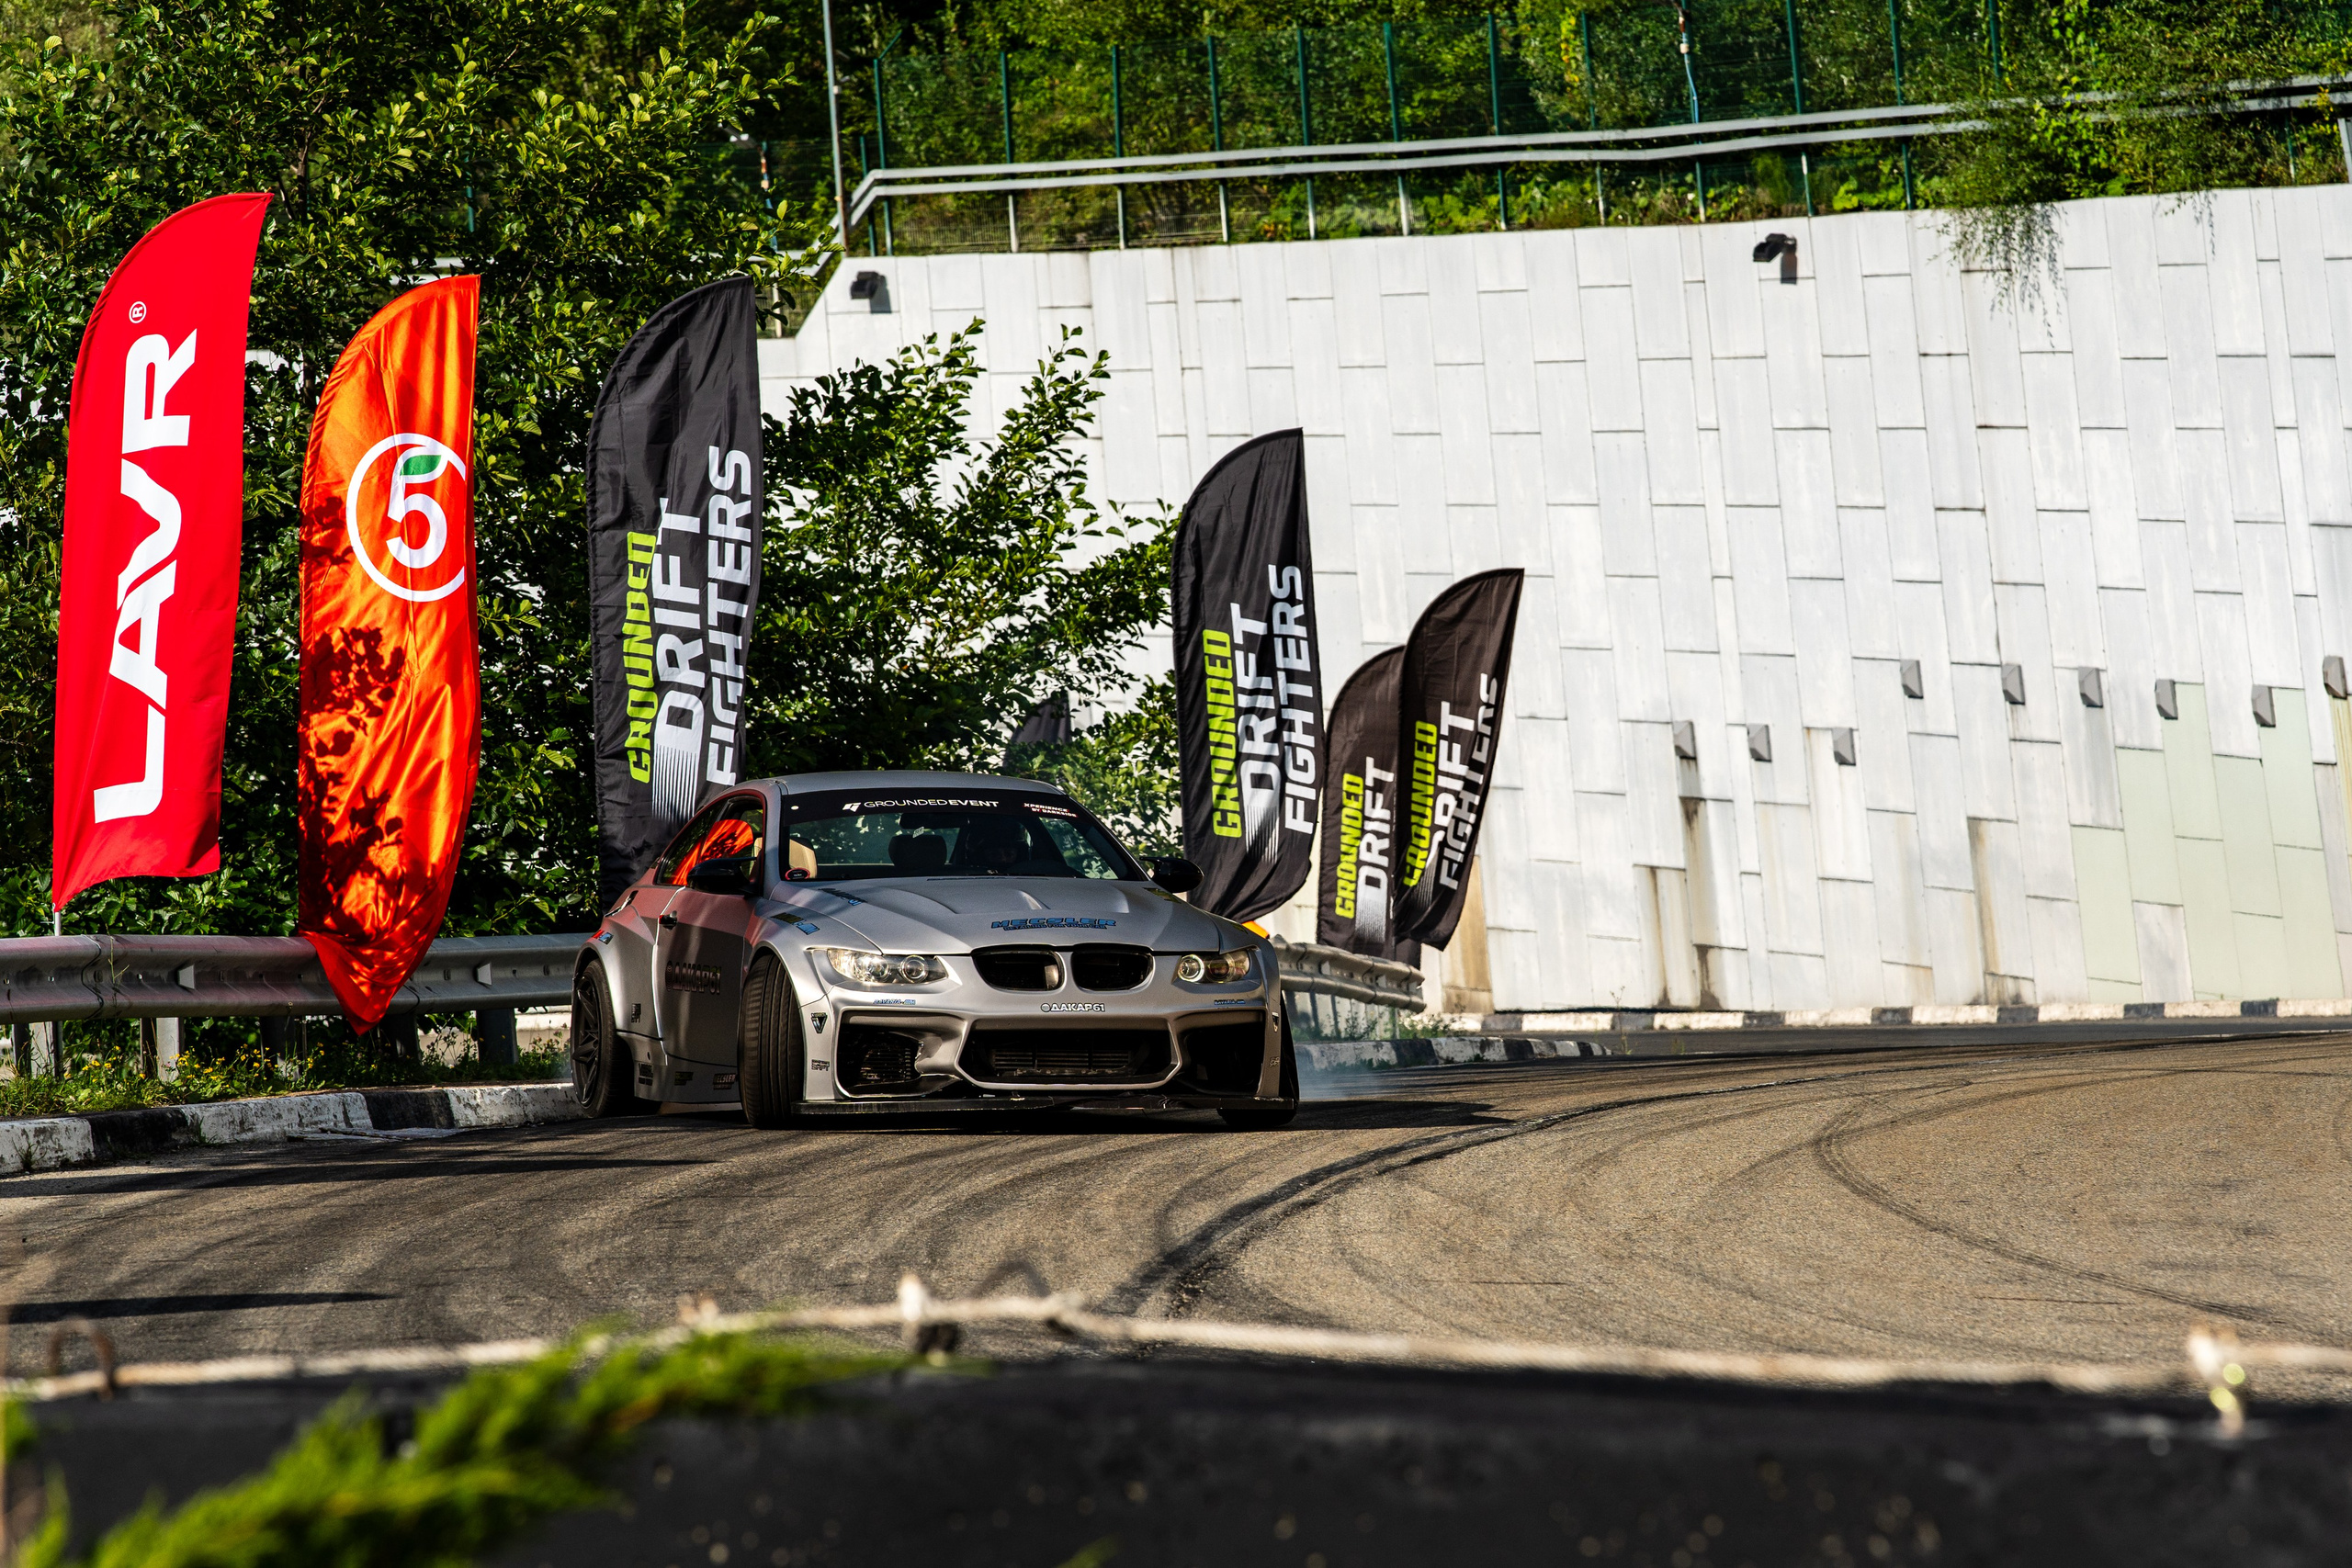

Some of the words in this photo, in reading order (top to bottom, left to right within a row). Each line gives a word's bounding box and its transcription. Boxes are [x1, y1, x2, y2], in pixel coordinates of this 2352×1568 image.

[94, 328, 198, 824] LAVR
[386, 446, 449, 570] 5
[707, 445, 752, 787] FIGHTERS
[622, 531, 659, 784] GROUNDED
[651, 497, 705, 818] DRIFT
[1203, 628, 1242, 839] GROUNDED
[1230, 602, 1281, 859] DRIFT
[1268, 563, 1317, 835] FIGHTERS
[1335, 773, 1364, 919] GROUNDED
[1355, 756, 1395, 937] DRIFT
